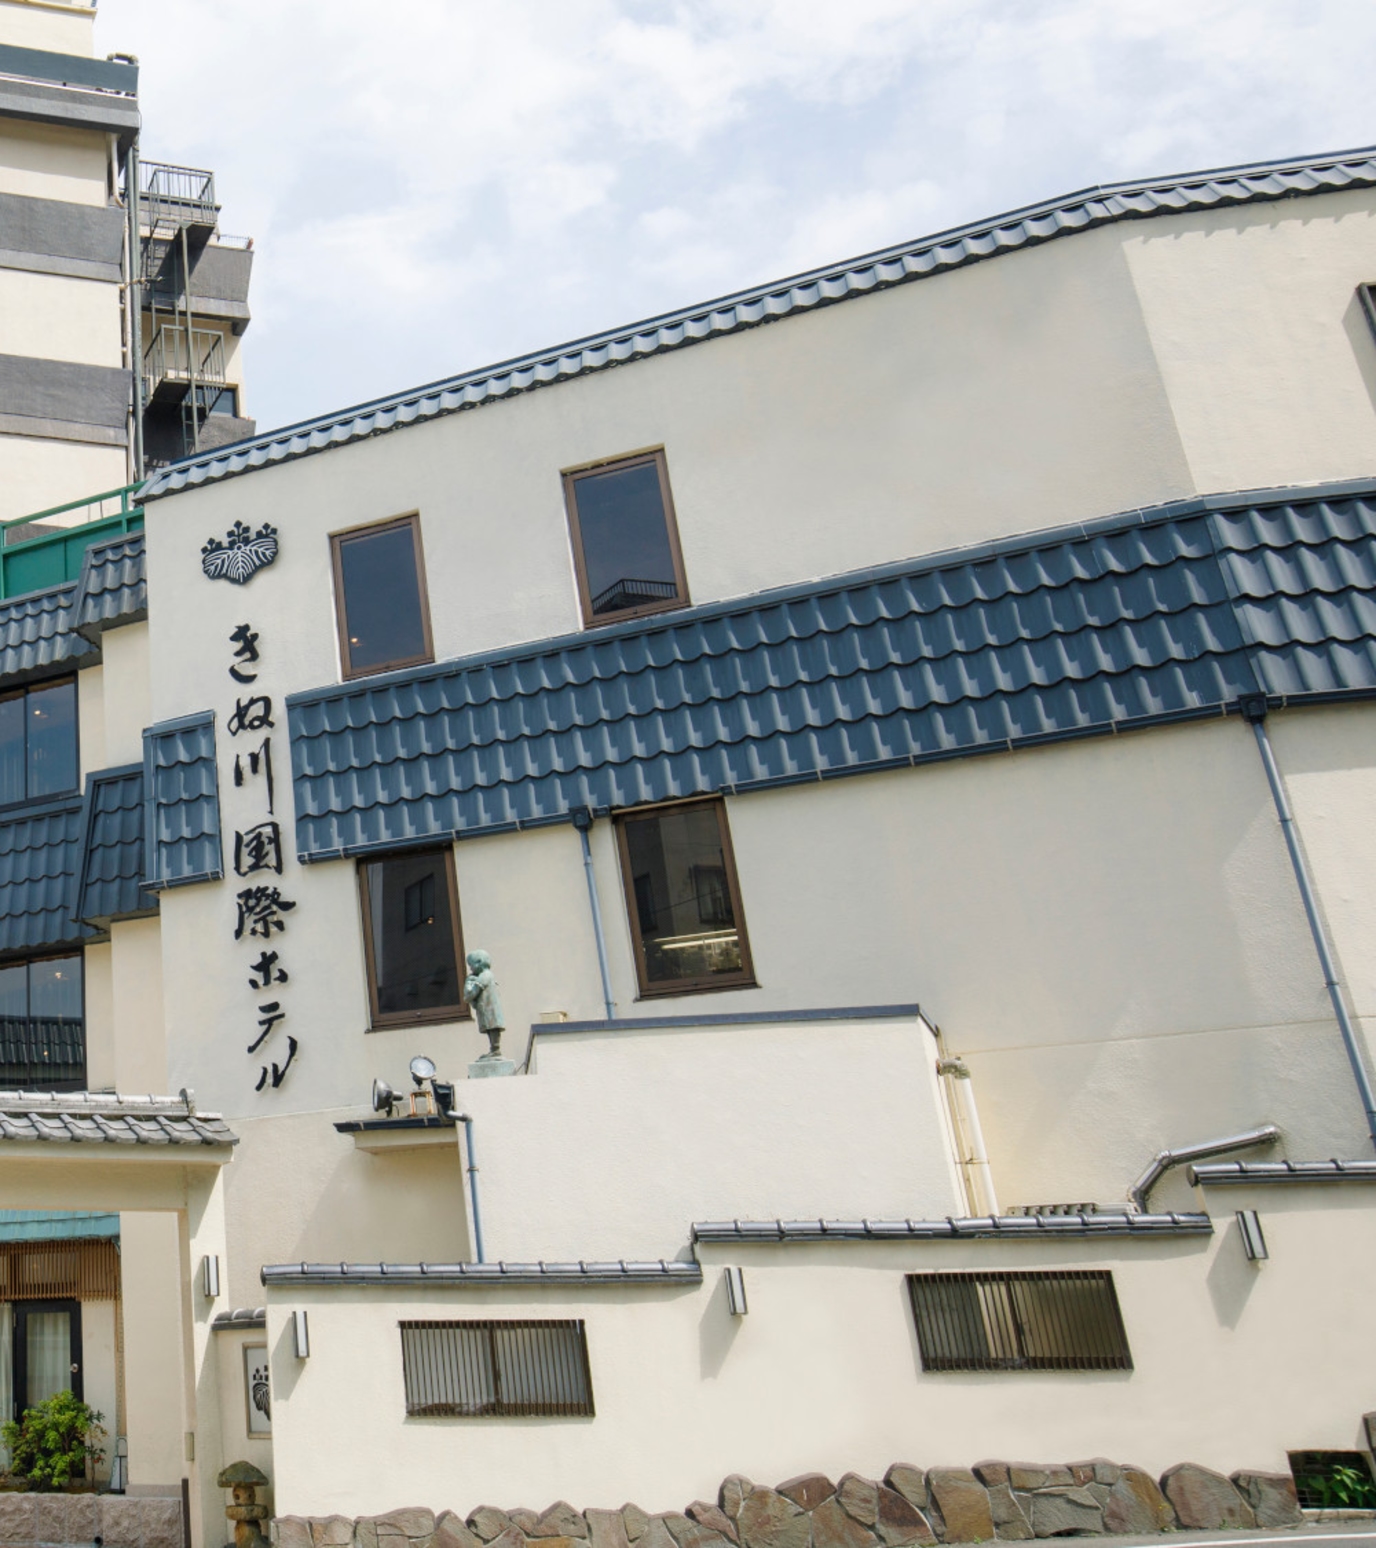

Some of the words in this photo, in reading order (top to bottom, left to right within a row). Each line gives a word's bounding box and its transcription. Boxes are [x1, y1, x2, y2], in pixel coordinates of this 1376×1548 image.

[227, 623, 298, 1092] きぬ川国際ホテル
